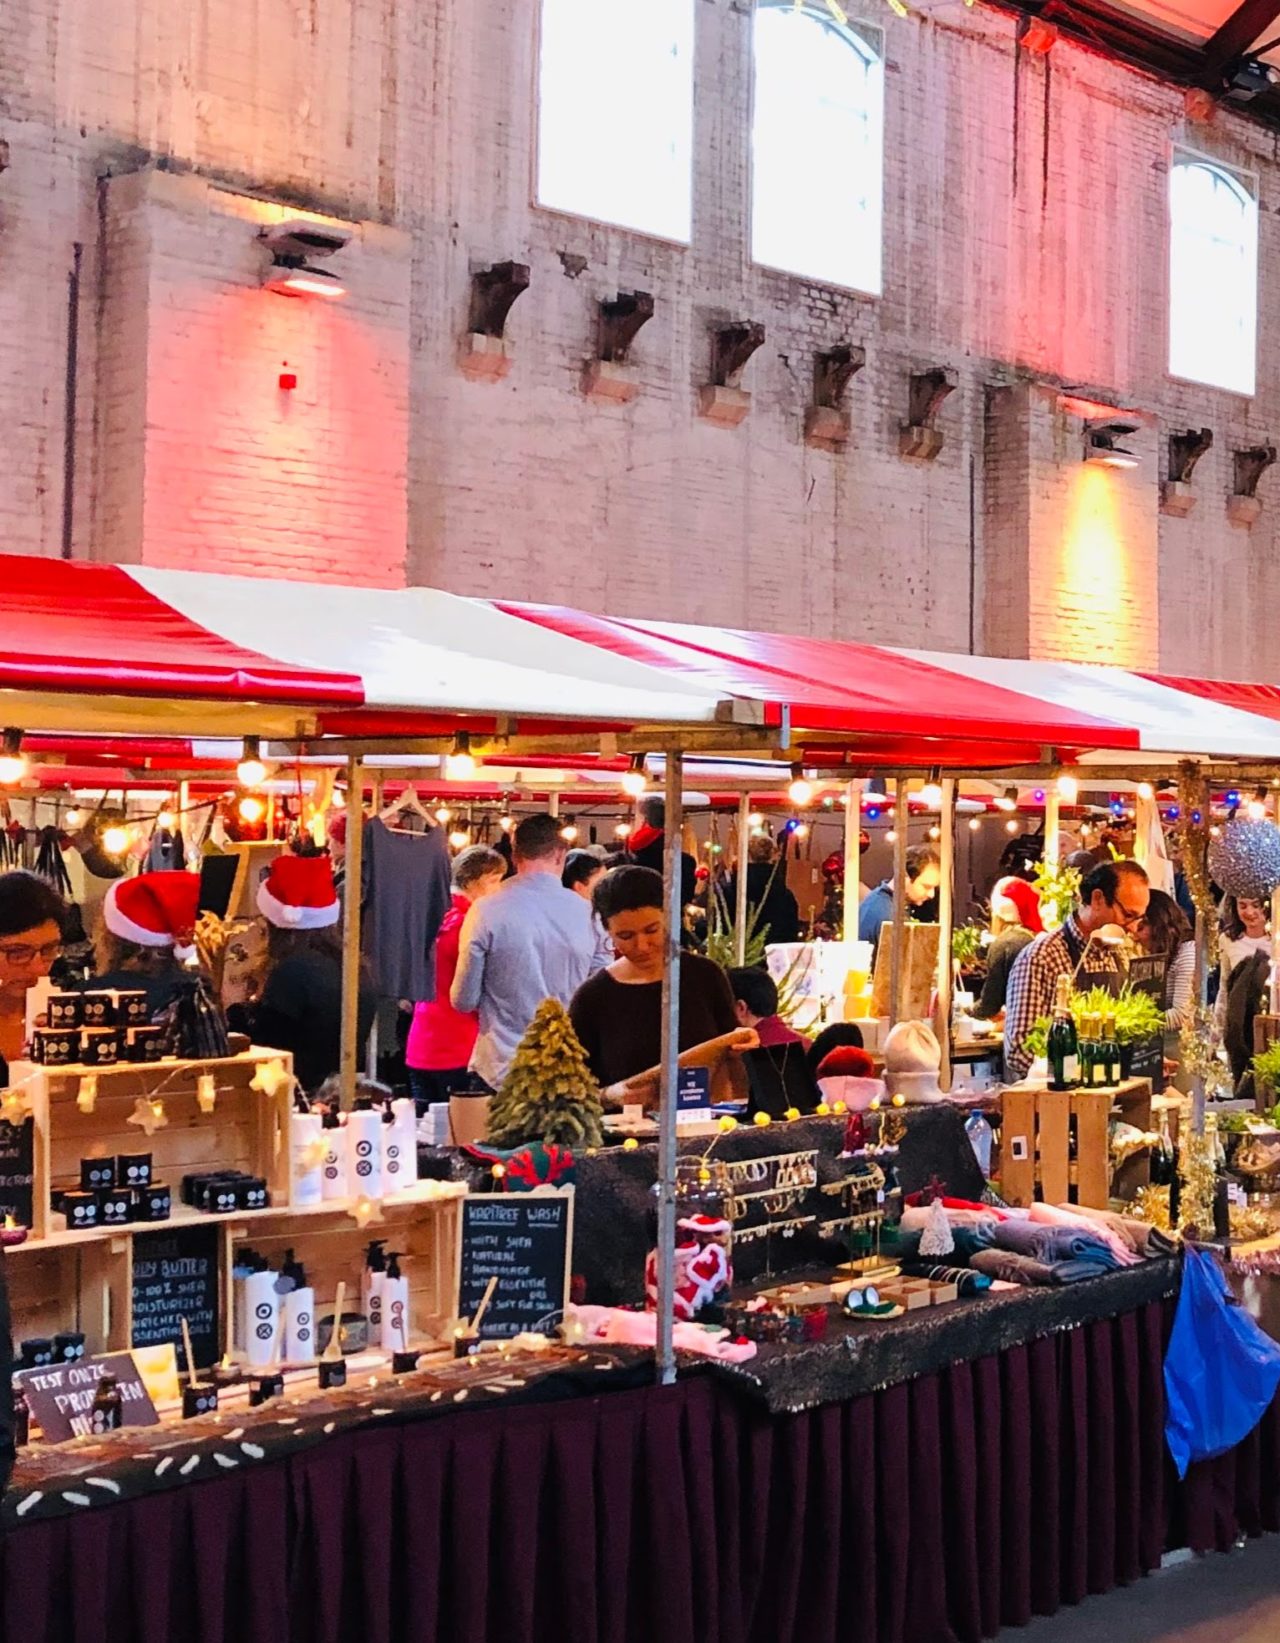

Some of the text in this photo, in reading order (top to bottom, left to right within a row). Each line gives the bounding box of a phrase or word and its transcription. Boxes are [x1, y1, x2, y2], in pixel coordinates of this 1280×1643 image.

[527, 1206, 561, 1222] WASH
[471, 1236, 532, 1249] WITH SHEA
[472, 1250, 516, 1262] NATURAL
[134, 1258, 208, 1279] ODY BUTTER
[499, 1277, 547, 1290] ESSENTIAL
[469, 1300, 492, 1312] VEY
[133, 1314, 184, 1328] NRICHED
[133, 1327, 184, 1342] SSENTIAL
[30, 1372, 62, 1391] TEST
